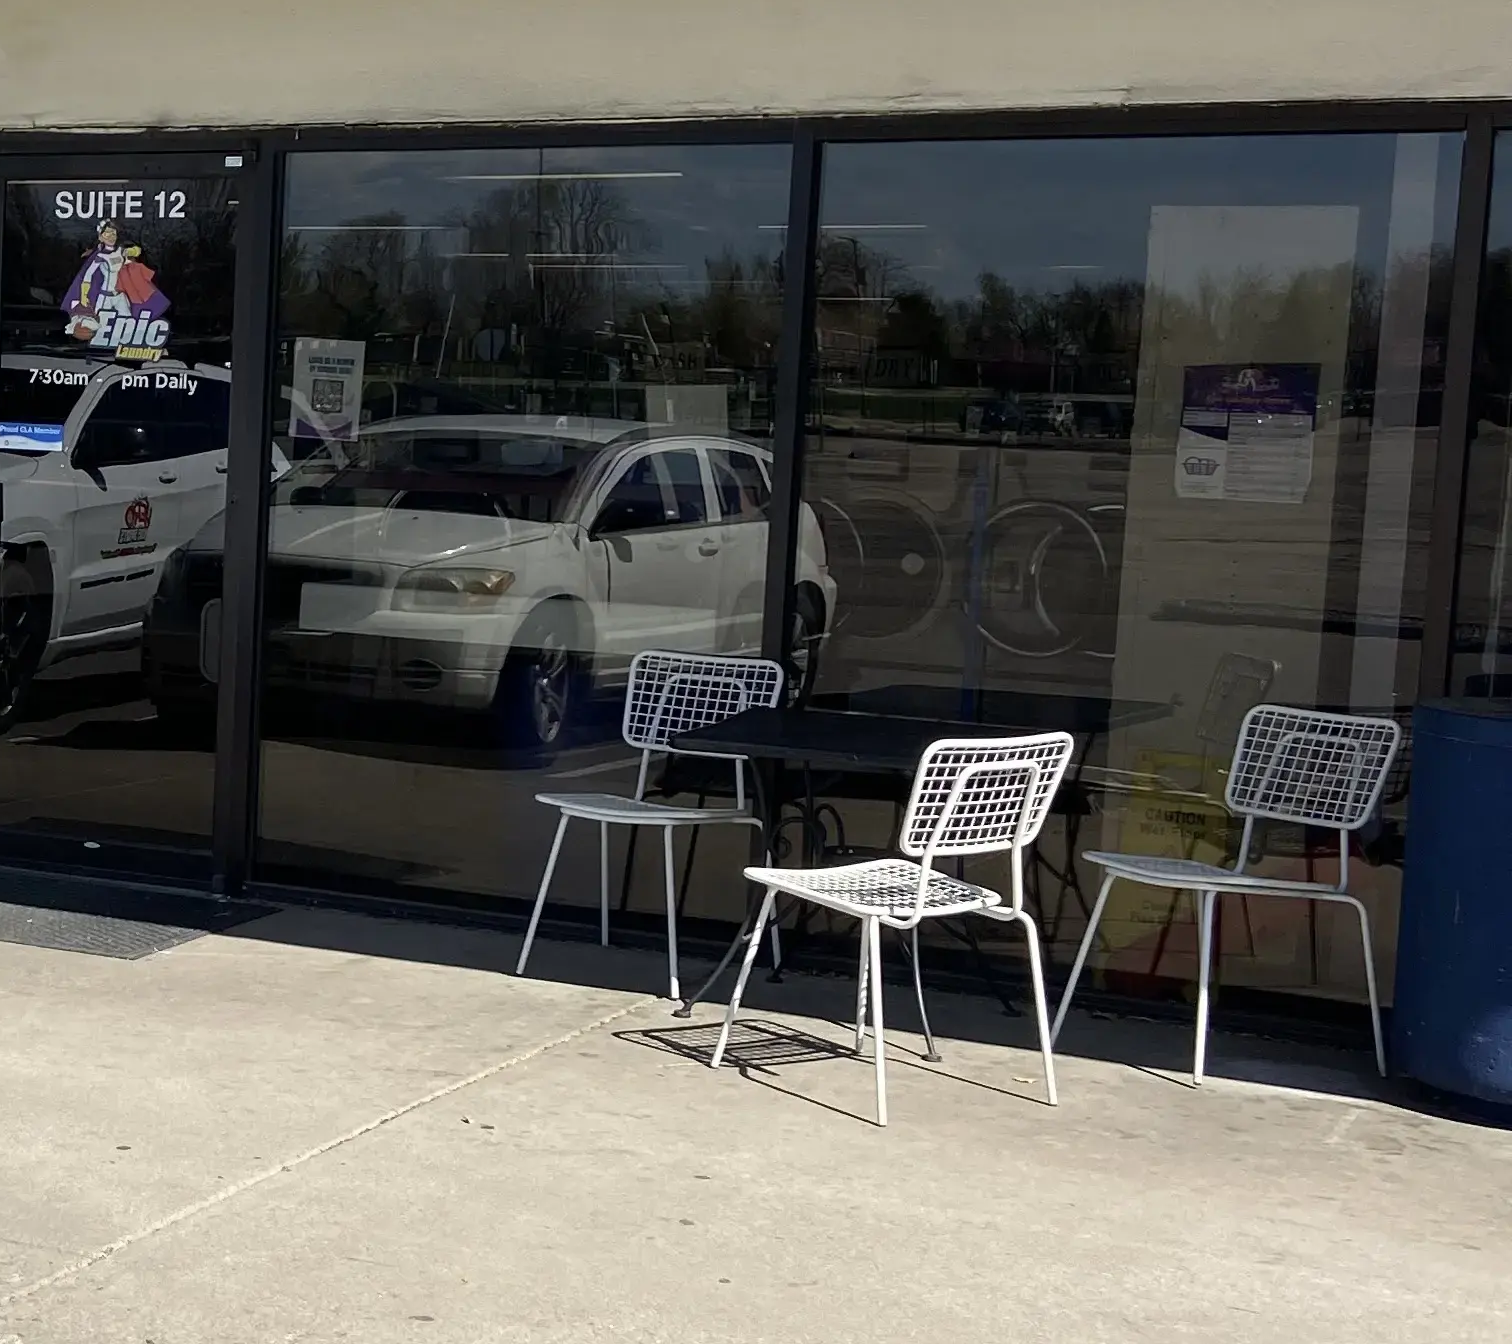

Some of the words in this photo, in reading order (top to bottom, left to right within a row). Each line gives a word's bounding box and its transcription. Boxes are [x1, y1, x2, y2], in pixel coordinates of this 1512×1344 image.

[55, 190, 143, 219] SUITE
[154, 190, 186, 219] 12
[90, 310, 169, 348] Epic
[115, 345, 163, 362] Laundry
[29, 368, 89, 385] 7:30am
[121, 374, 149, 390] pm
[155, 373, 198, 396] Daily
